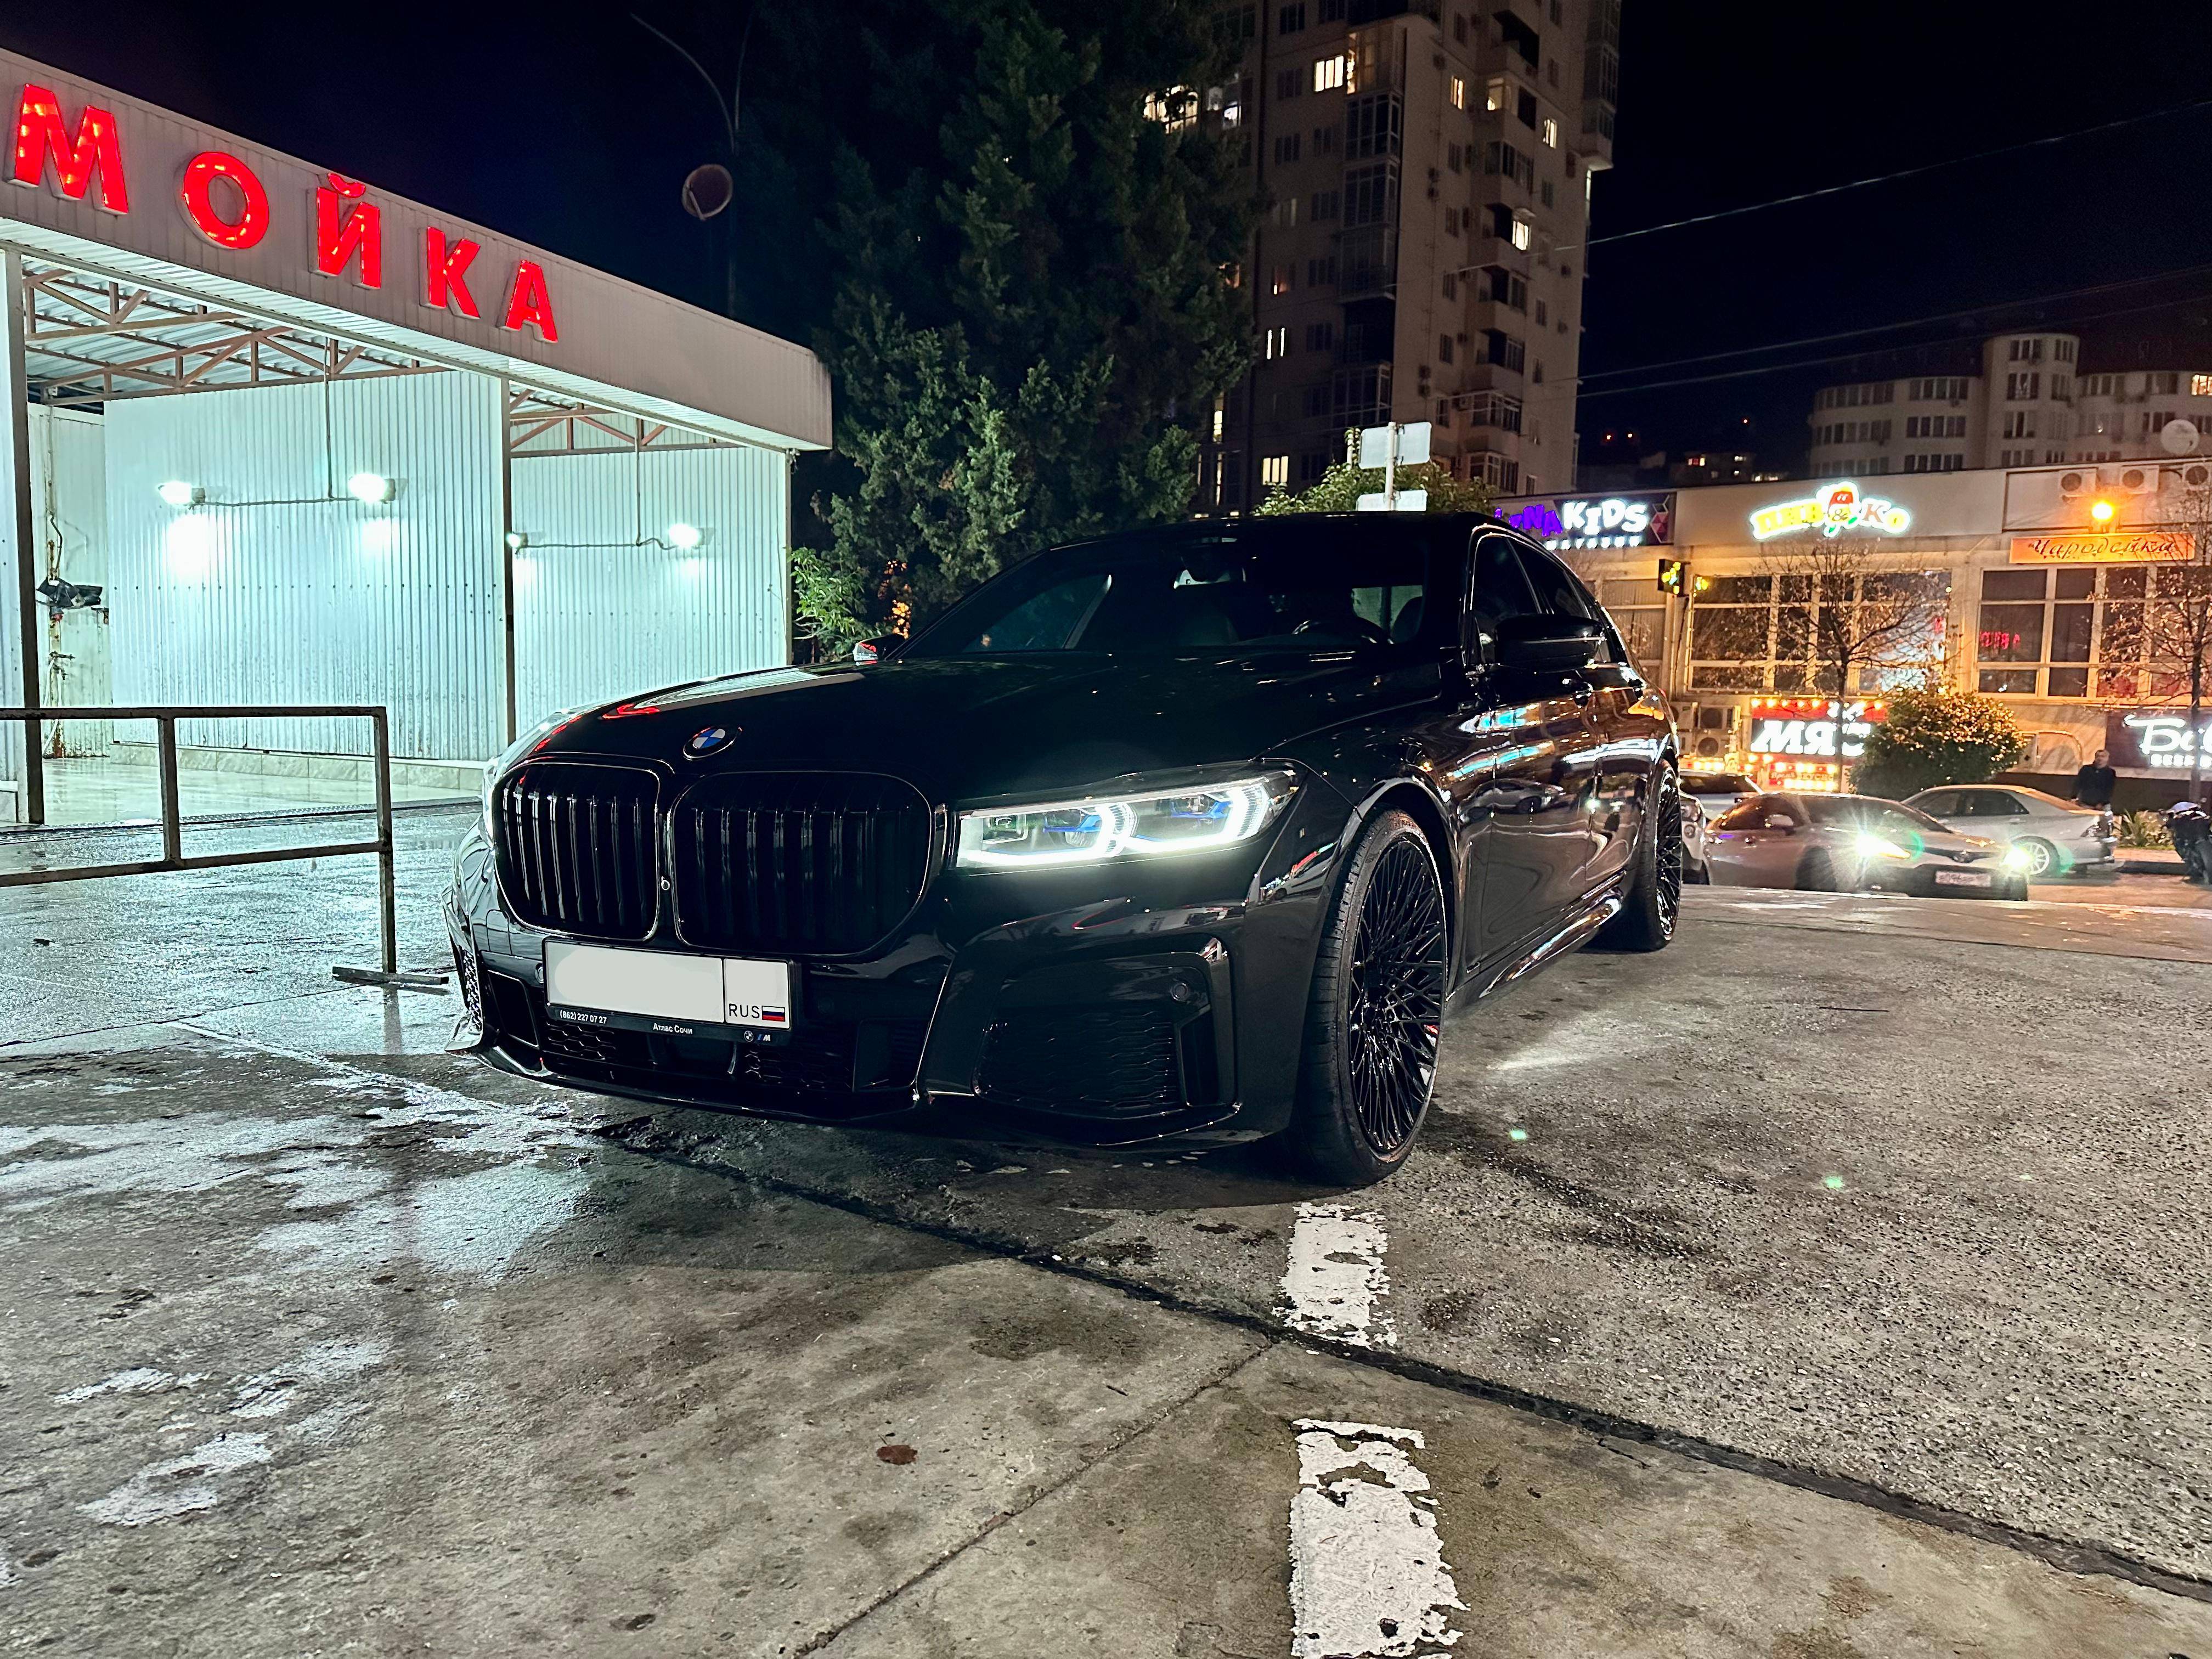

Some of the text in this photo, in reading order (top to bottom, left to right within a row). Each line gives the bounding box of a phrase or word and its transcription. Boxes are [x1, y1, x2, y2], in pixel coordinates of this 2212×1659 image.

[7, 83, 558, 343] МОЙКА
[1563, 500, 1646, 535] KIDS
[2029, 537, 2176, 559] Чародейка
[560, 1009, 577, 1020] (862)
[590, 1014, 598, 1023] 07
[729, 1003, 760, 1019] RUS
[653, 1023, 693, 1035] Атлас Сочи
